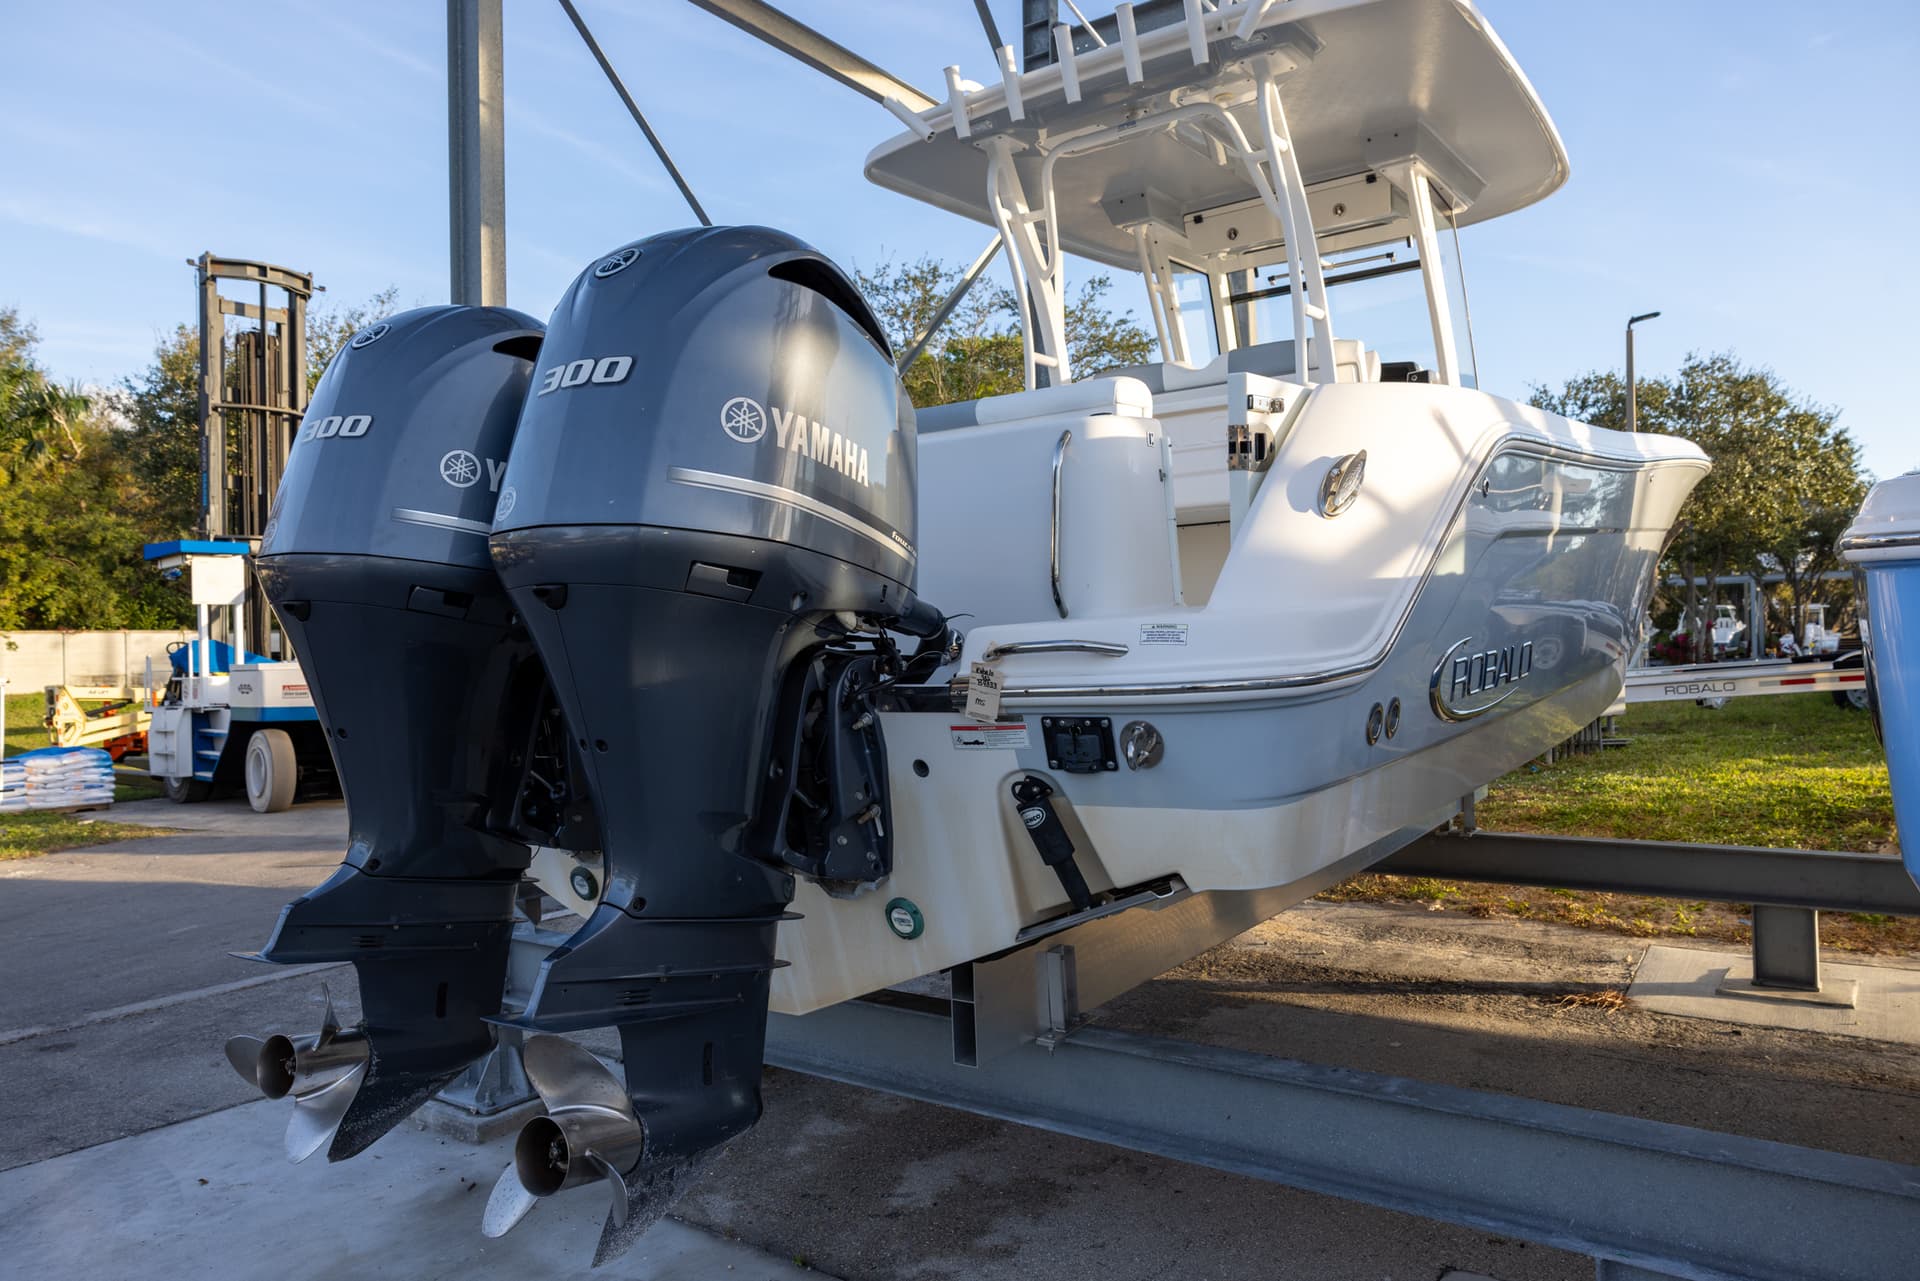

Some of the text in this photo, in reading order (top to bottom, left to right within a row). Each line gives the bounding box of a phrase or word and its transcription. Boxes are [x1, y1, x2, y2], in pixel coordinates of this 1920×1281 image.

[537, 356, 633, 396] 300
[303, 415, 372, 442] 300
[771, 407, 869, 488] YAMAHA
[1450, 641, 1533, 703] ROBALO
[1664, 681, 1736, 696] ROBALO
